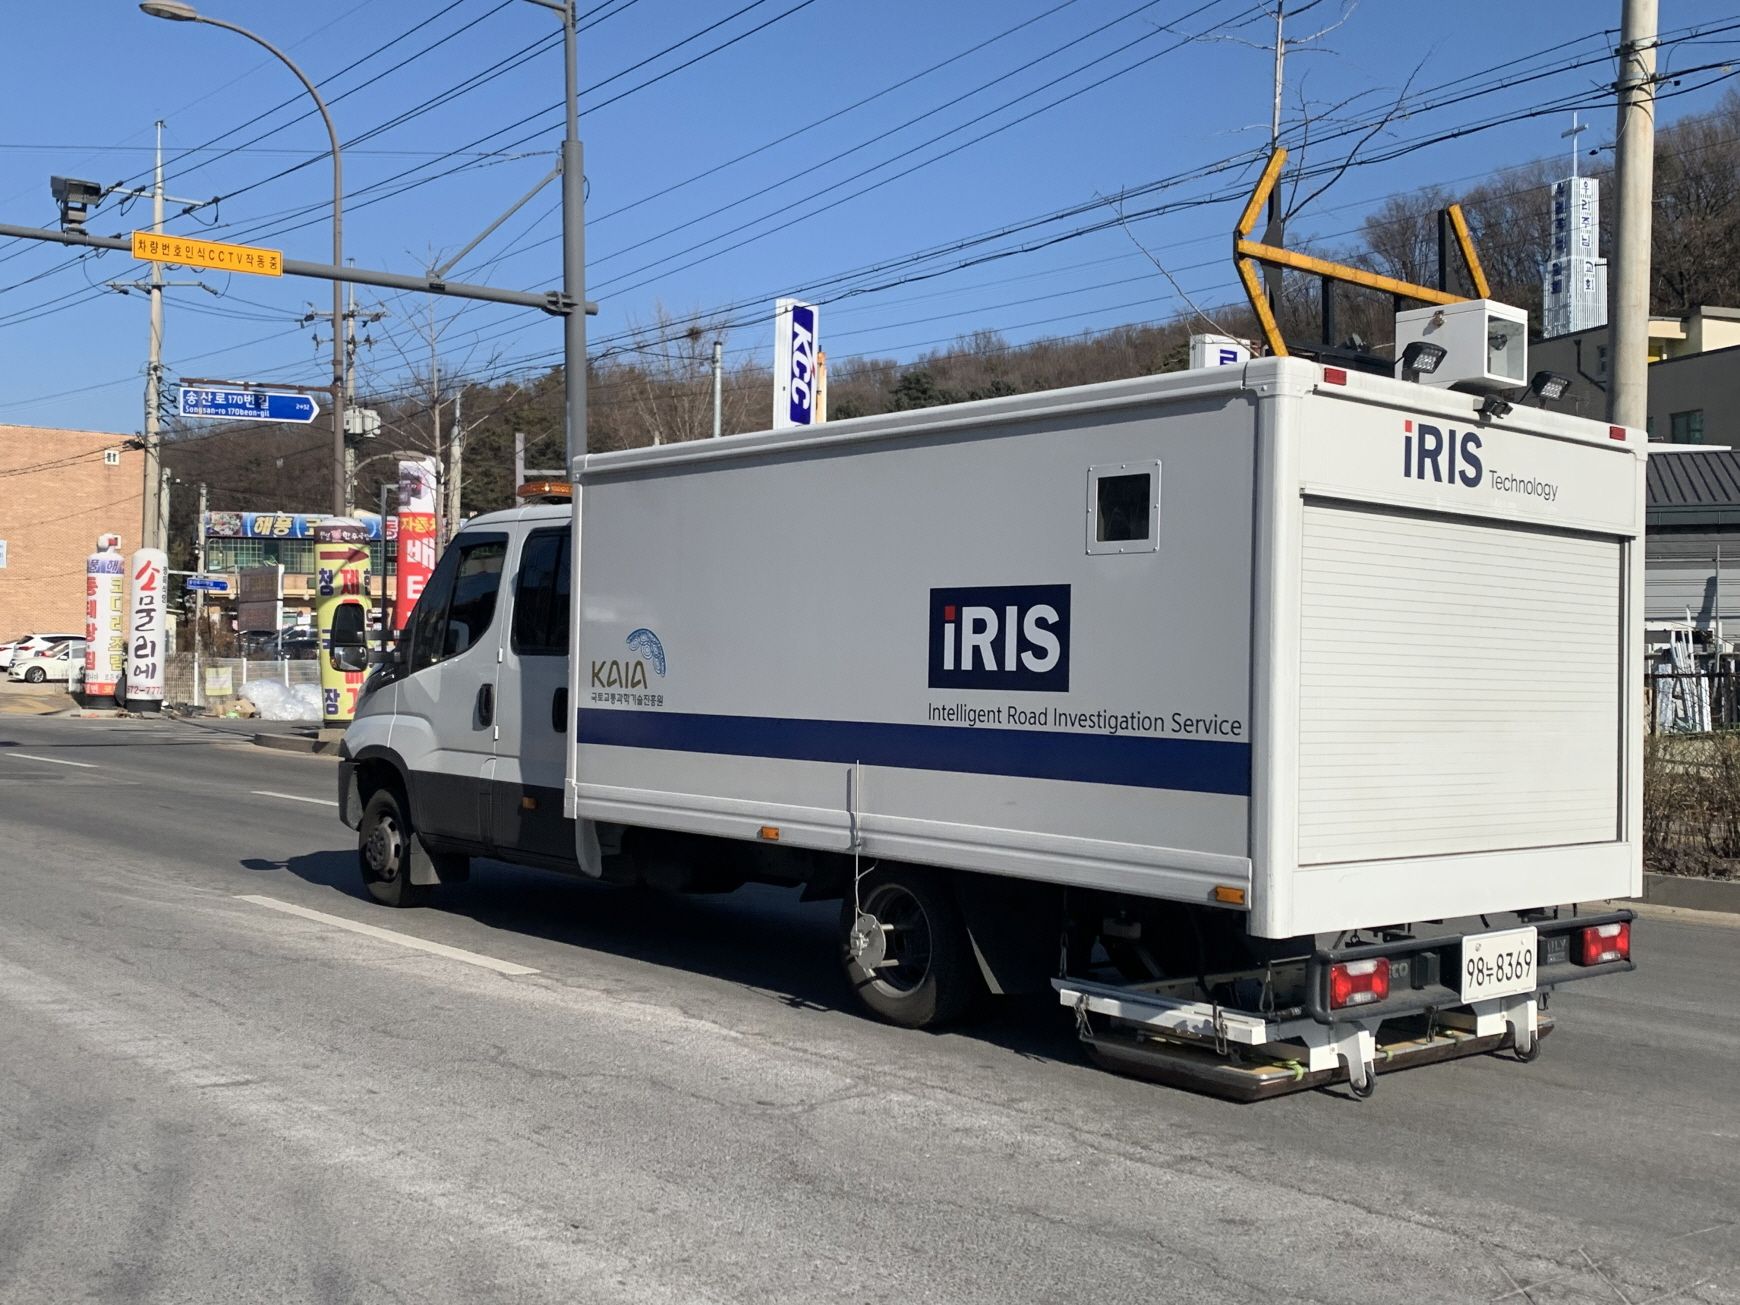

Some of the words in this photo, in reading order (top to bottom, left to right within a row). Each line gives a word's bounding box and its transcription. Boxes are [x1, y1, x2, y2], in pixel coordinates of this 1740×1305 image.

[791, 321, 814, 410] KCC
[185, 405, 226, 415] Songsan-ro
[227, 407, 270, 418] 170beon-gil
[1489, 469, 1558, 501] Technology
[254, 516, 292, 536] 해풍
[592, 659, 648, 689] KAIA
[591, 692, 664, 706] 국토교통과학기술진흥원
[928, 702, 1002, 727] Intelligent
[1007, 705, 1048, 727] Road
[1053, 707, 1165, 735] Investigation
[1171, 712, 1242, 736] Service
[1467, 948, 1532, 988] 98누8369
